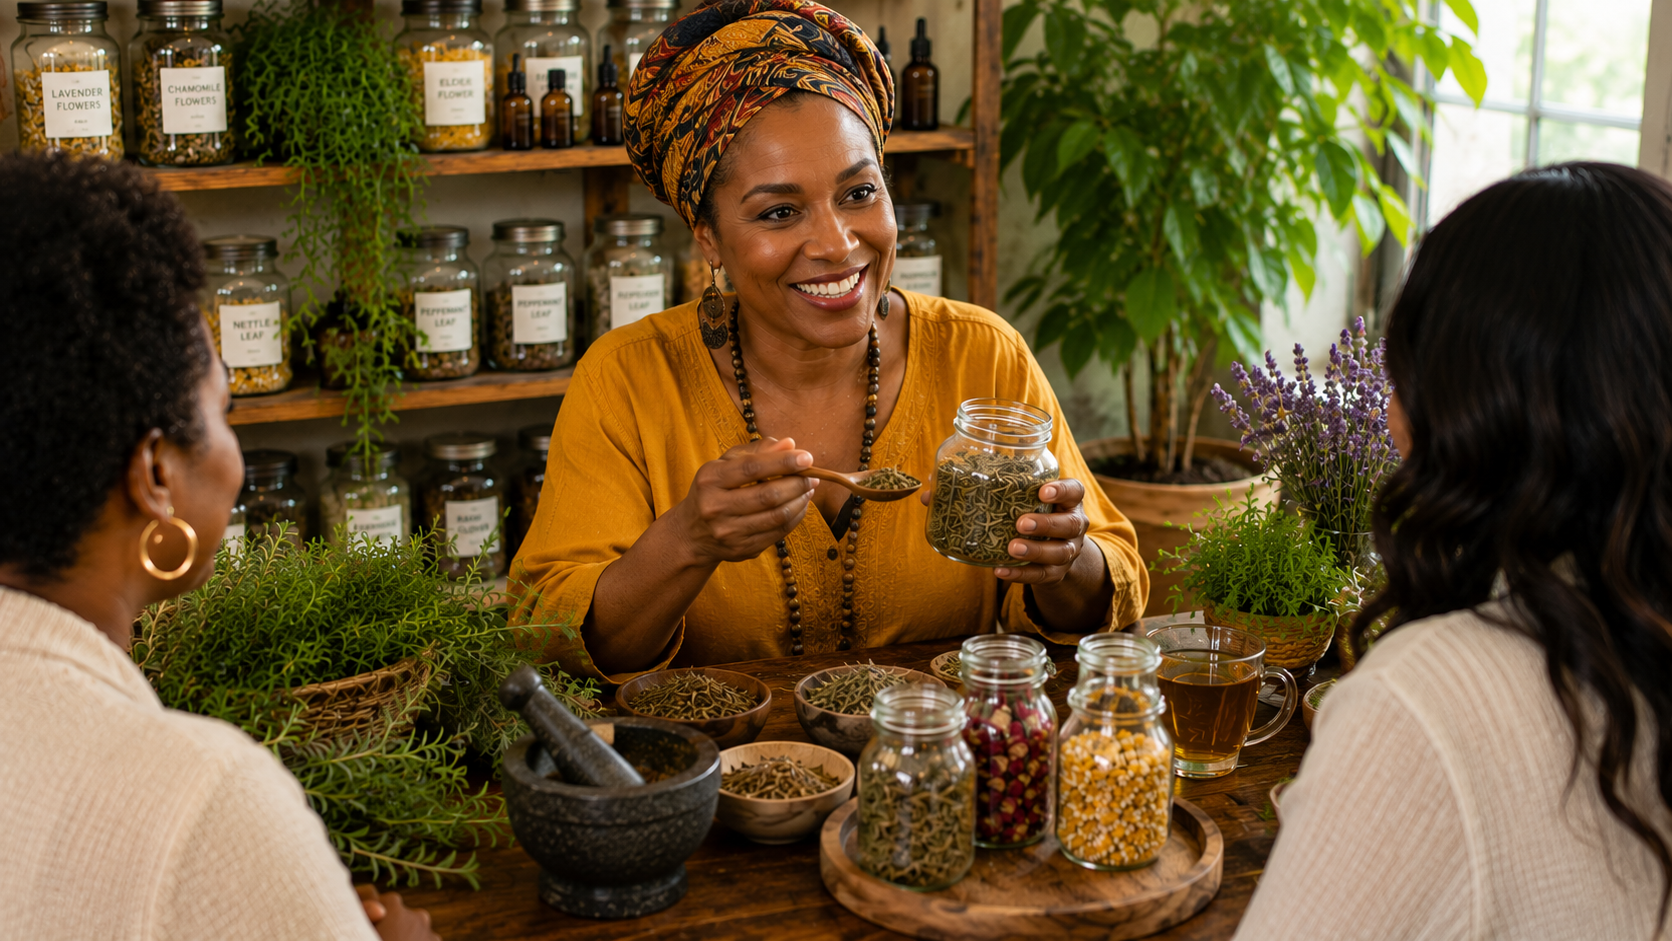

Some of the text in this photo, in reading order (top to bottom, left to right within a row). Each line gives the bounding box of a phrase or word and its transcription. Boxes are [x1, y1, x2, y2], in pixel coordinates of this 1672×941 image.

[439, 77, 472, 87] ELDER
[51, 87, 103, 98] LAVENDER
[168, 83, 221, 94] CHAMOMILE
[438, 90, 474, 99] FLOWER
[57, 100, 101, 111] FLOWERS
[175, 96, 217, 106] FLOWERS
[233, 318, 270, 330] NETTLE
[240, 331, 264, 341] LEAF
